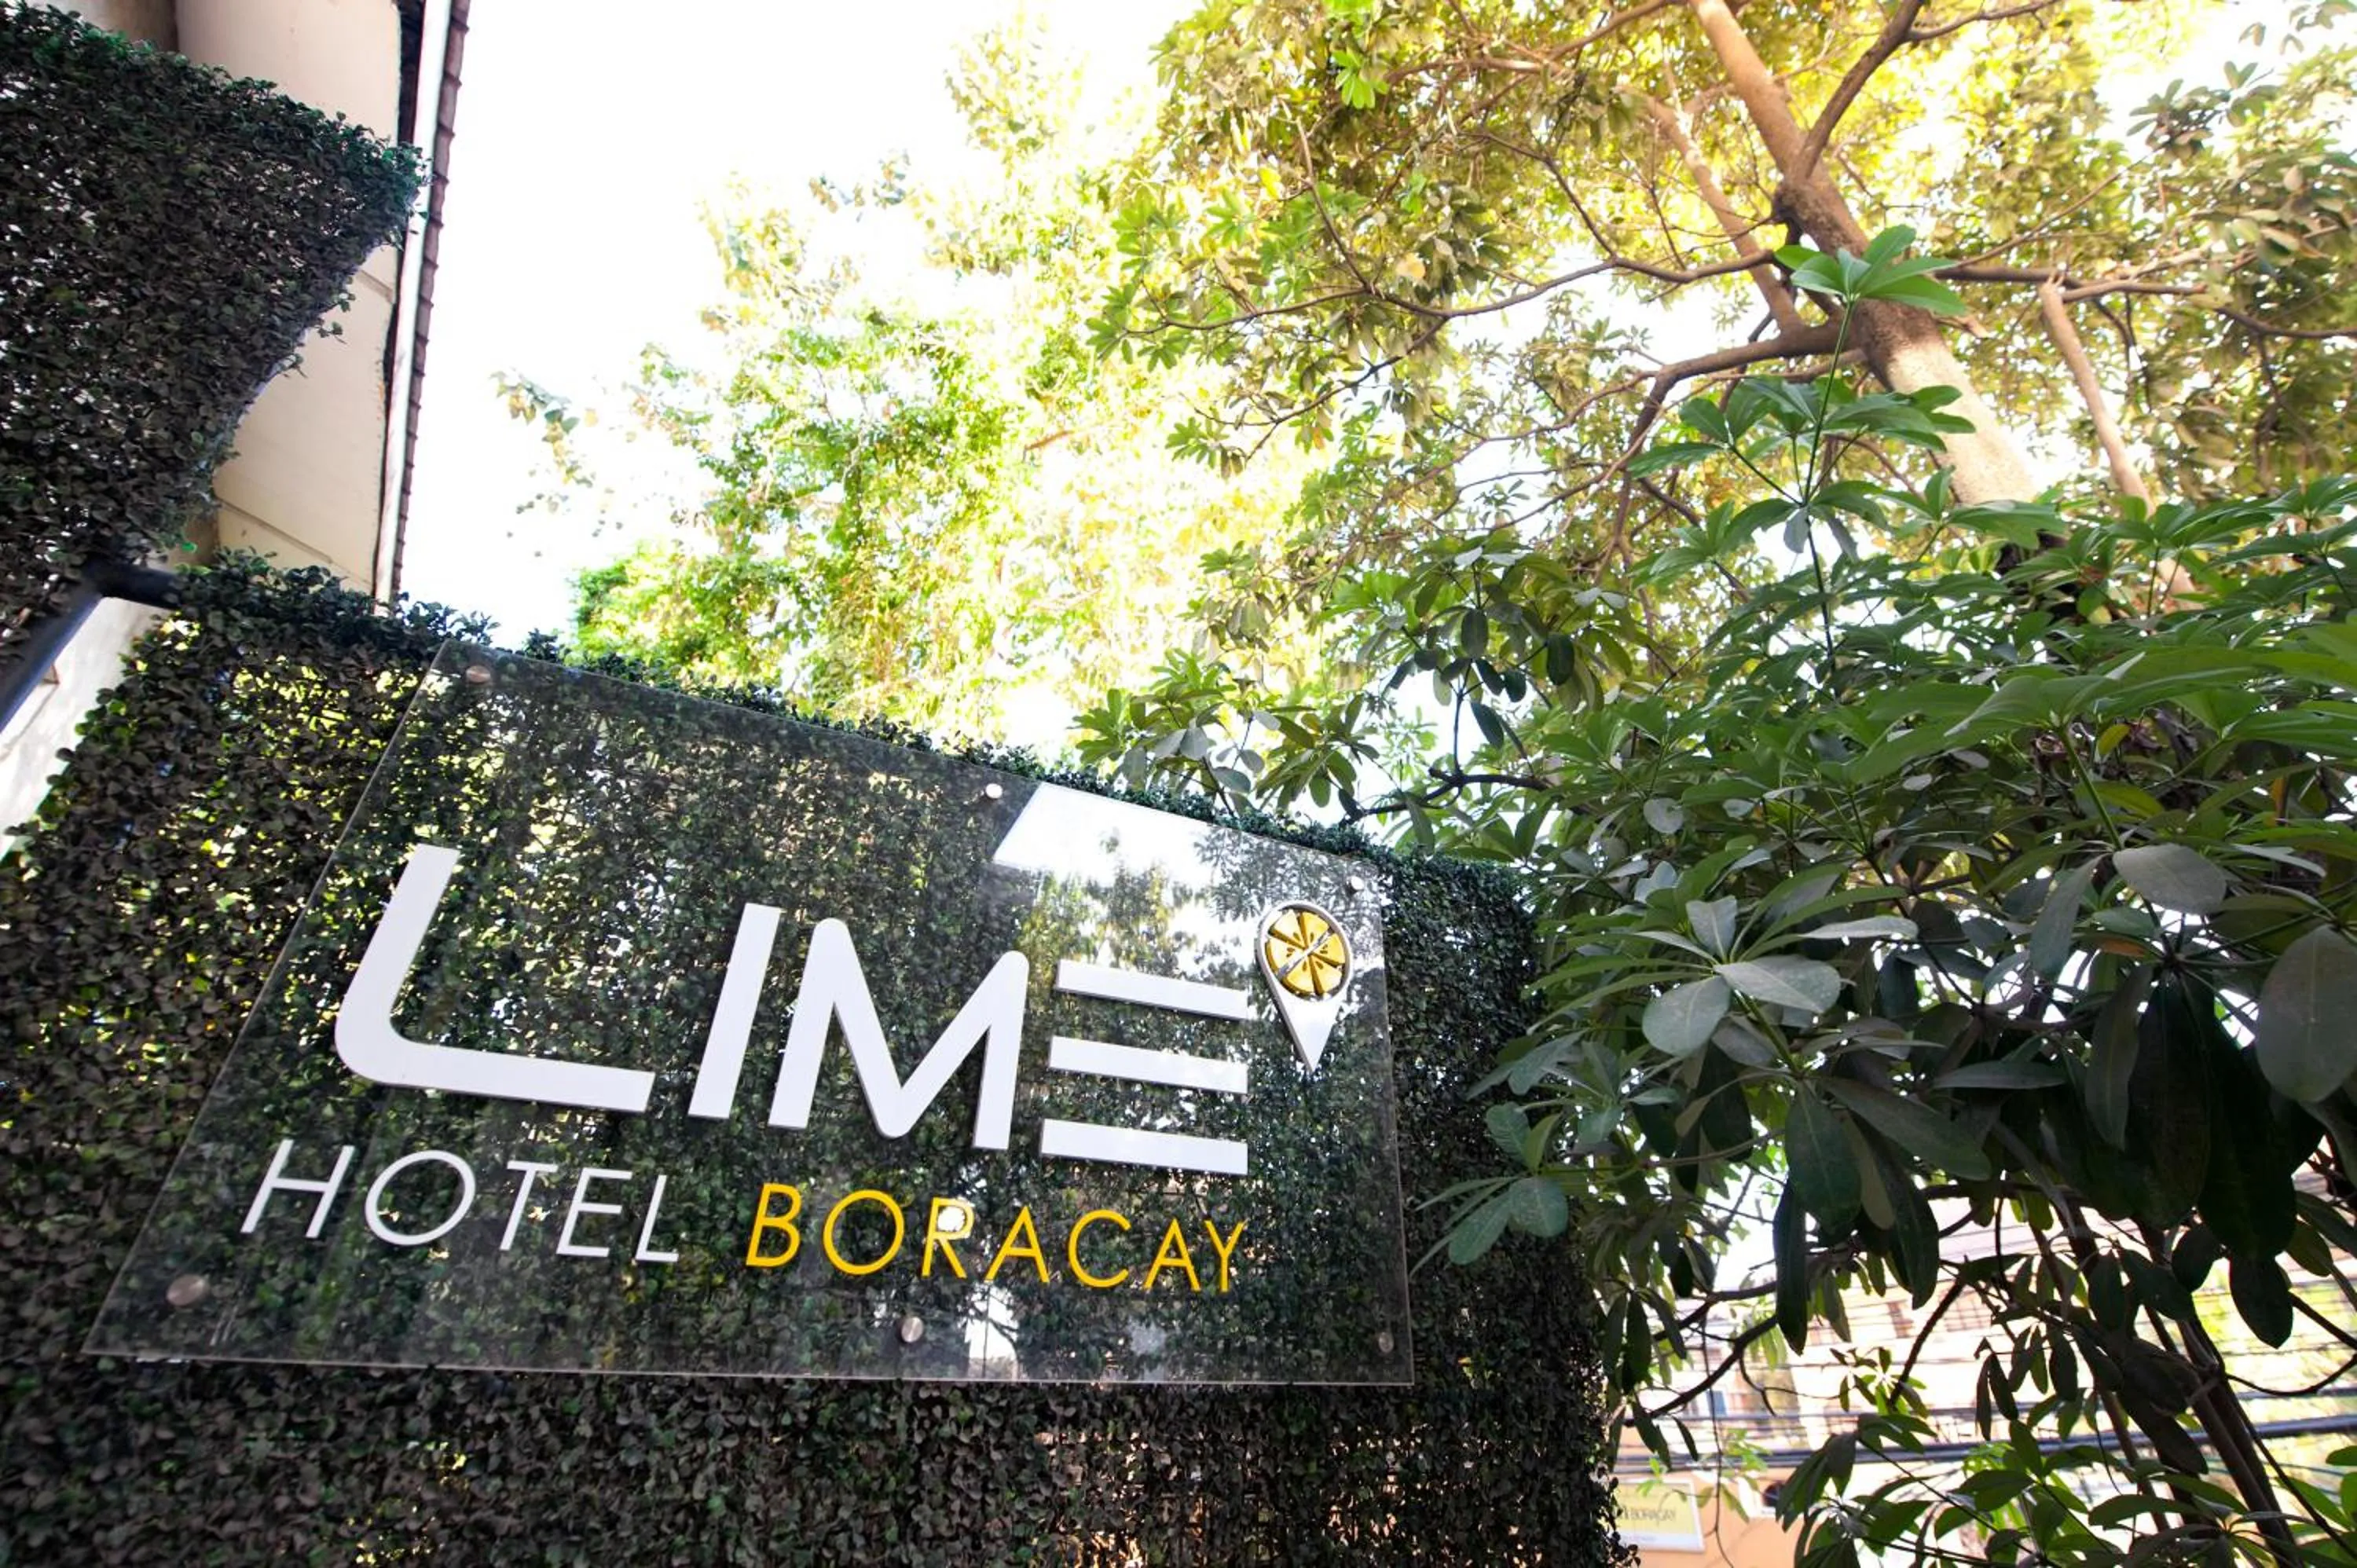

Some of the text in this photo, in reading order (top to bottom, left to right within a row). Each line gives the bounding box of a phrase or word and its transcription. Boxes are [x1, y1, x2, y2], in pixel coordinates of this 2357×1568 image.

[335, 843, 1249, 1176] LIME
[240, 1138, 1249, 1293] HOTEL BORACAY
